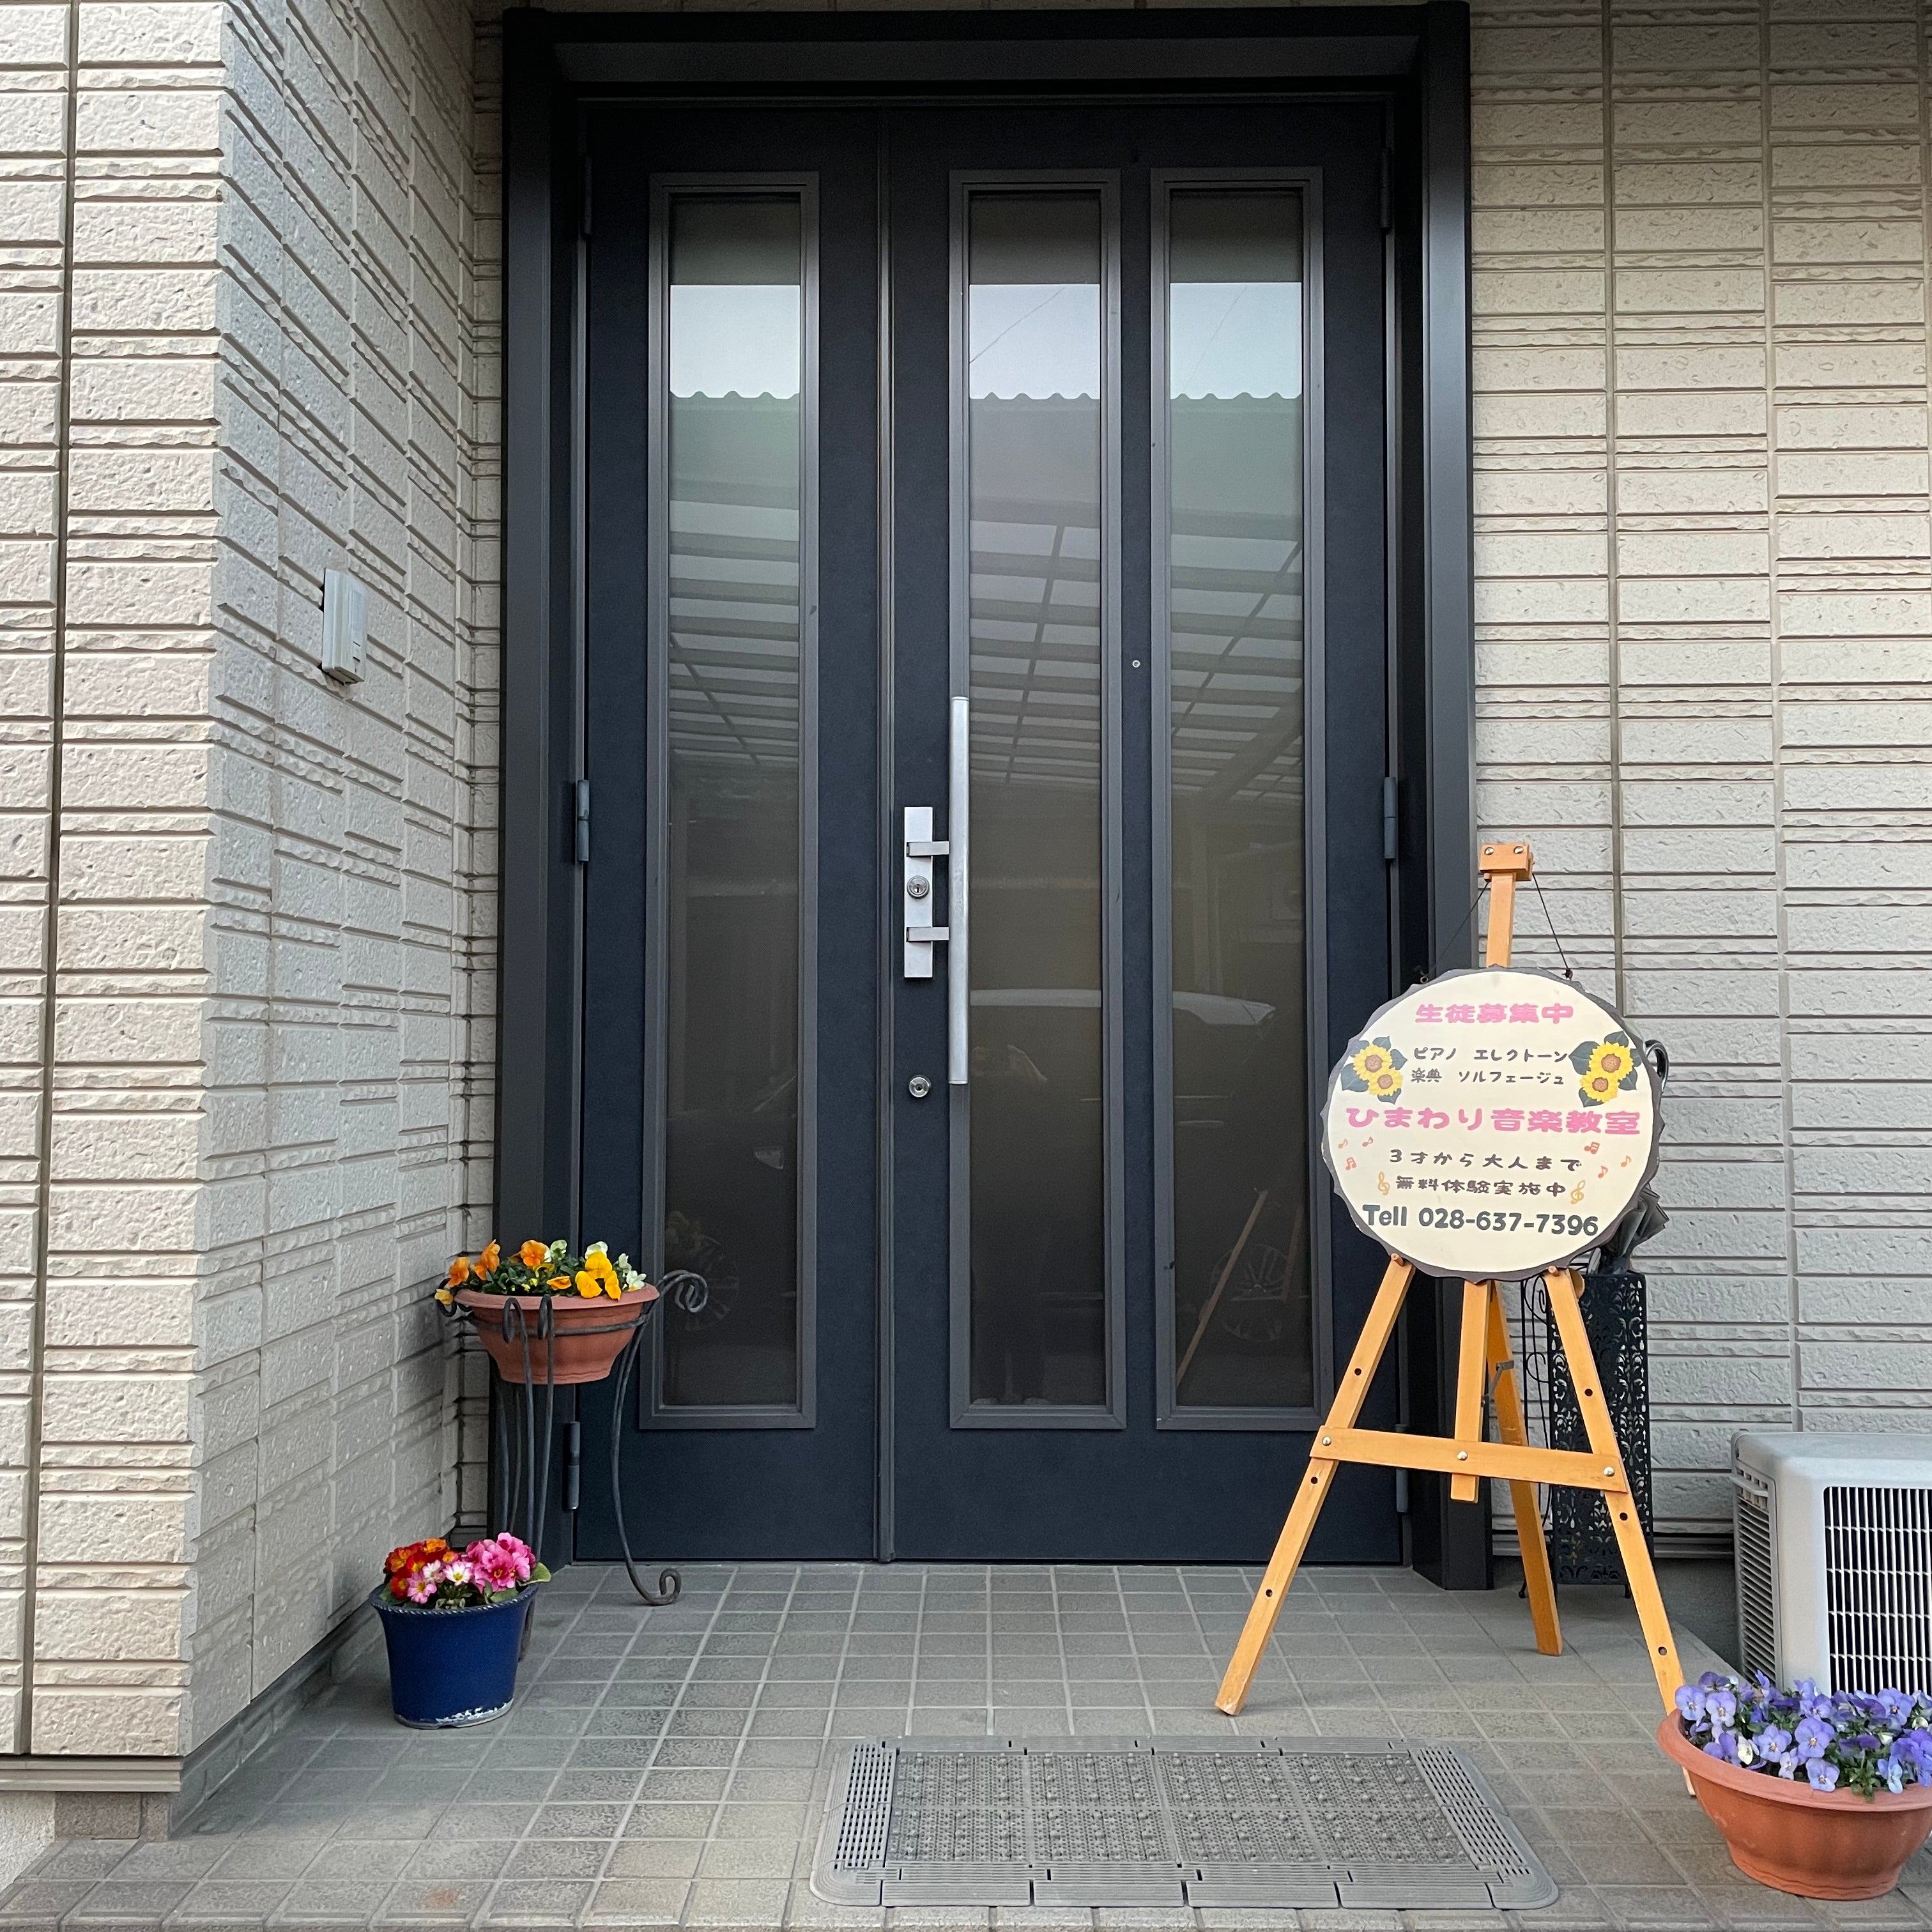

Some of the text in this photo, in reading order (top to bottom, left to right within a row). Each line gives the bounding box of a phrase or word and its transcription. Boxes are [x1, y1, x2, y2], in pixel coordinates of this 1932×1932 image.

[1414, 1003, 1574, 1024] 生徒募集中
[1414, 1046, 1568, 1062] ピアノ エレクトーン
[1411, 1068, 1564, 1085] 楽典 ソルフェージュ
[1346, 1107, 1641, 1135] ひまわり音楽教室
[1396, 1176, 1567, 1197] 無料体験実施中
[1362, 1204, 1598, 1236] Tell 028-637-7396
